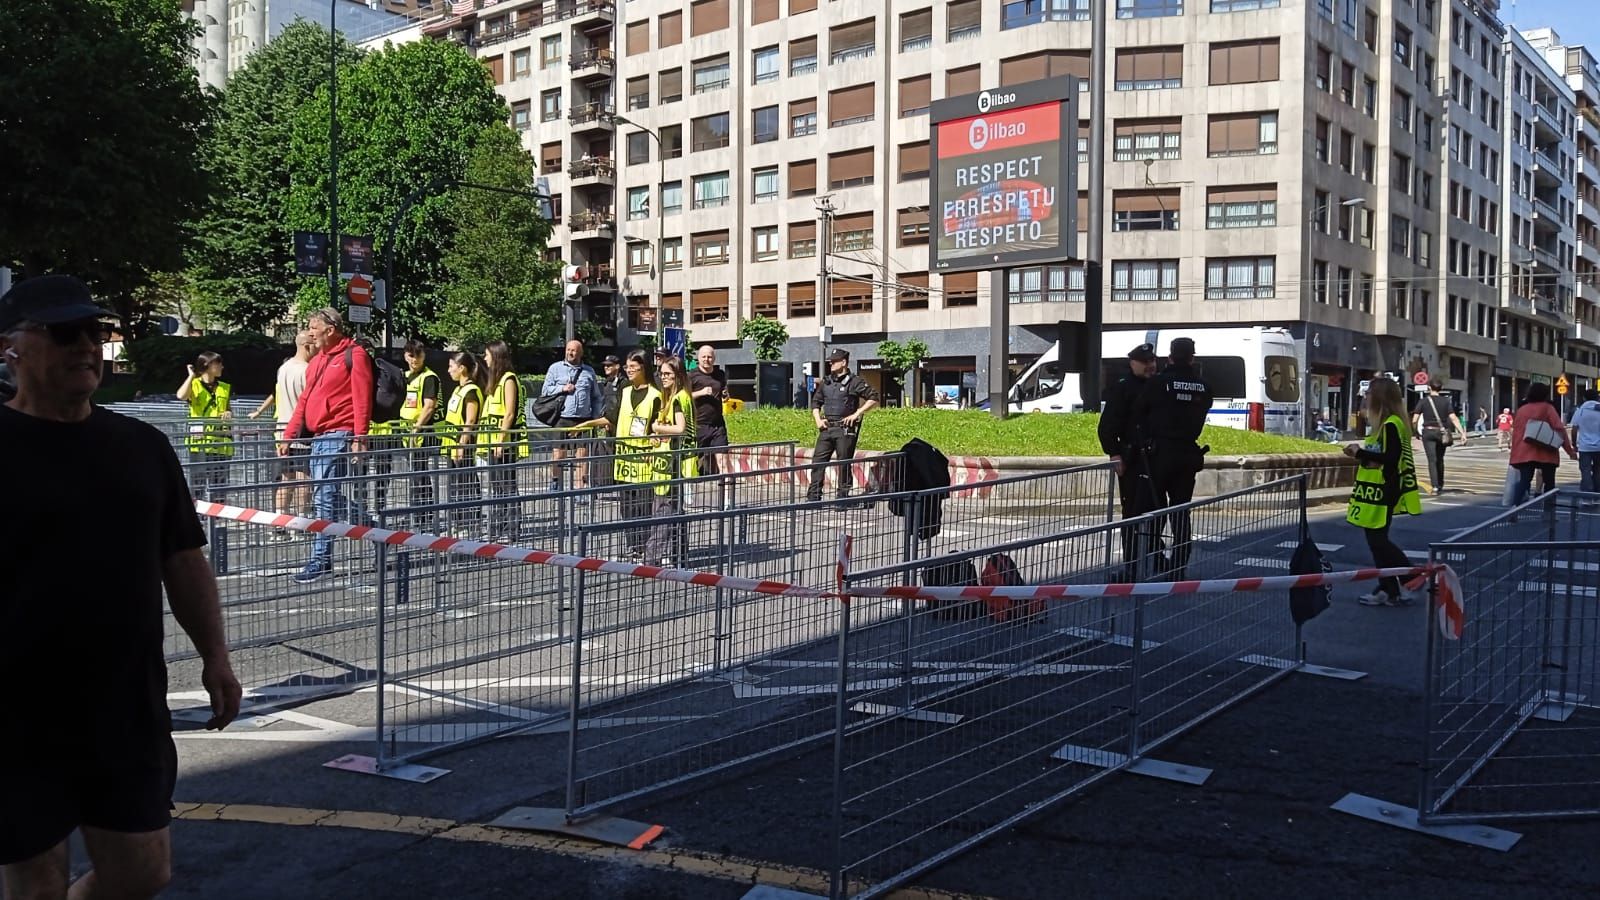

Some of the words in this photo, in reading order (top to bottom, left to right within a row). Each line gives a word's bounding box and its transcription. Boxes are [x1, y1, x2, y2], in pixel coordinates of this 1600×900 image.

[978, 91, 1016, 113] Bilbao
[969, 118, 1026, 150] Bilbao
[956, 156, 1042, 187] RESPECT
[943, 186, 1055, 220] ERRESPETU
[955, 221, 1042, 249] RESPETO
